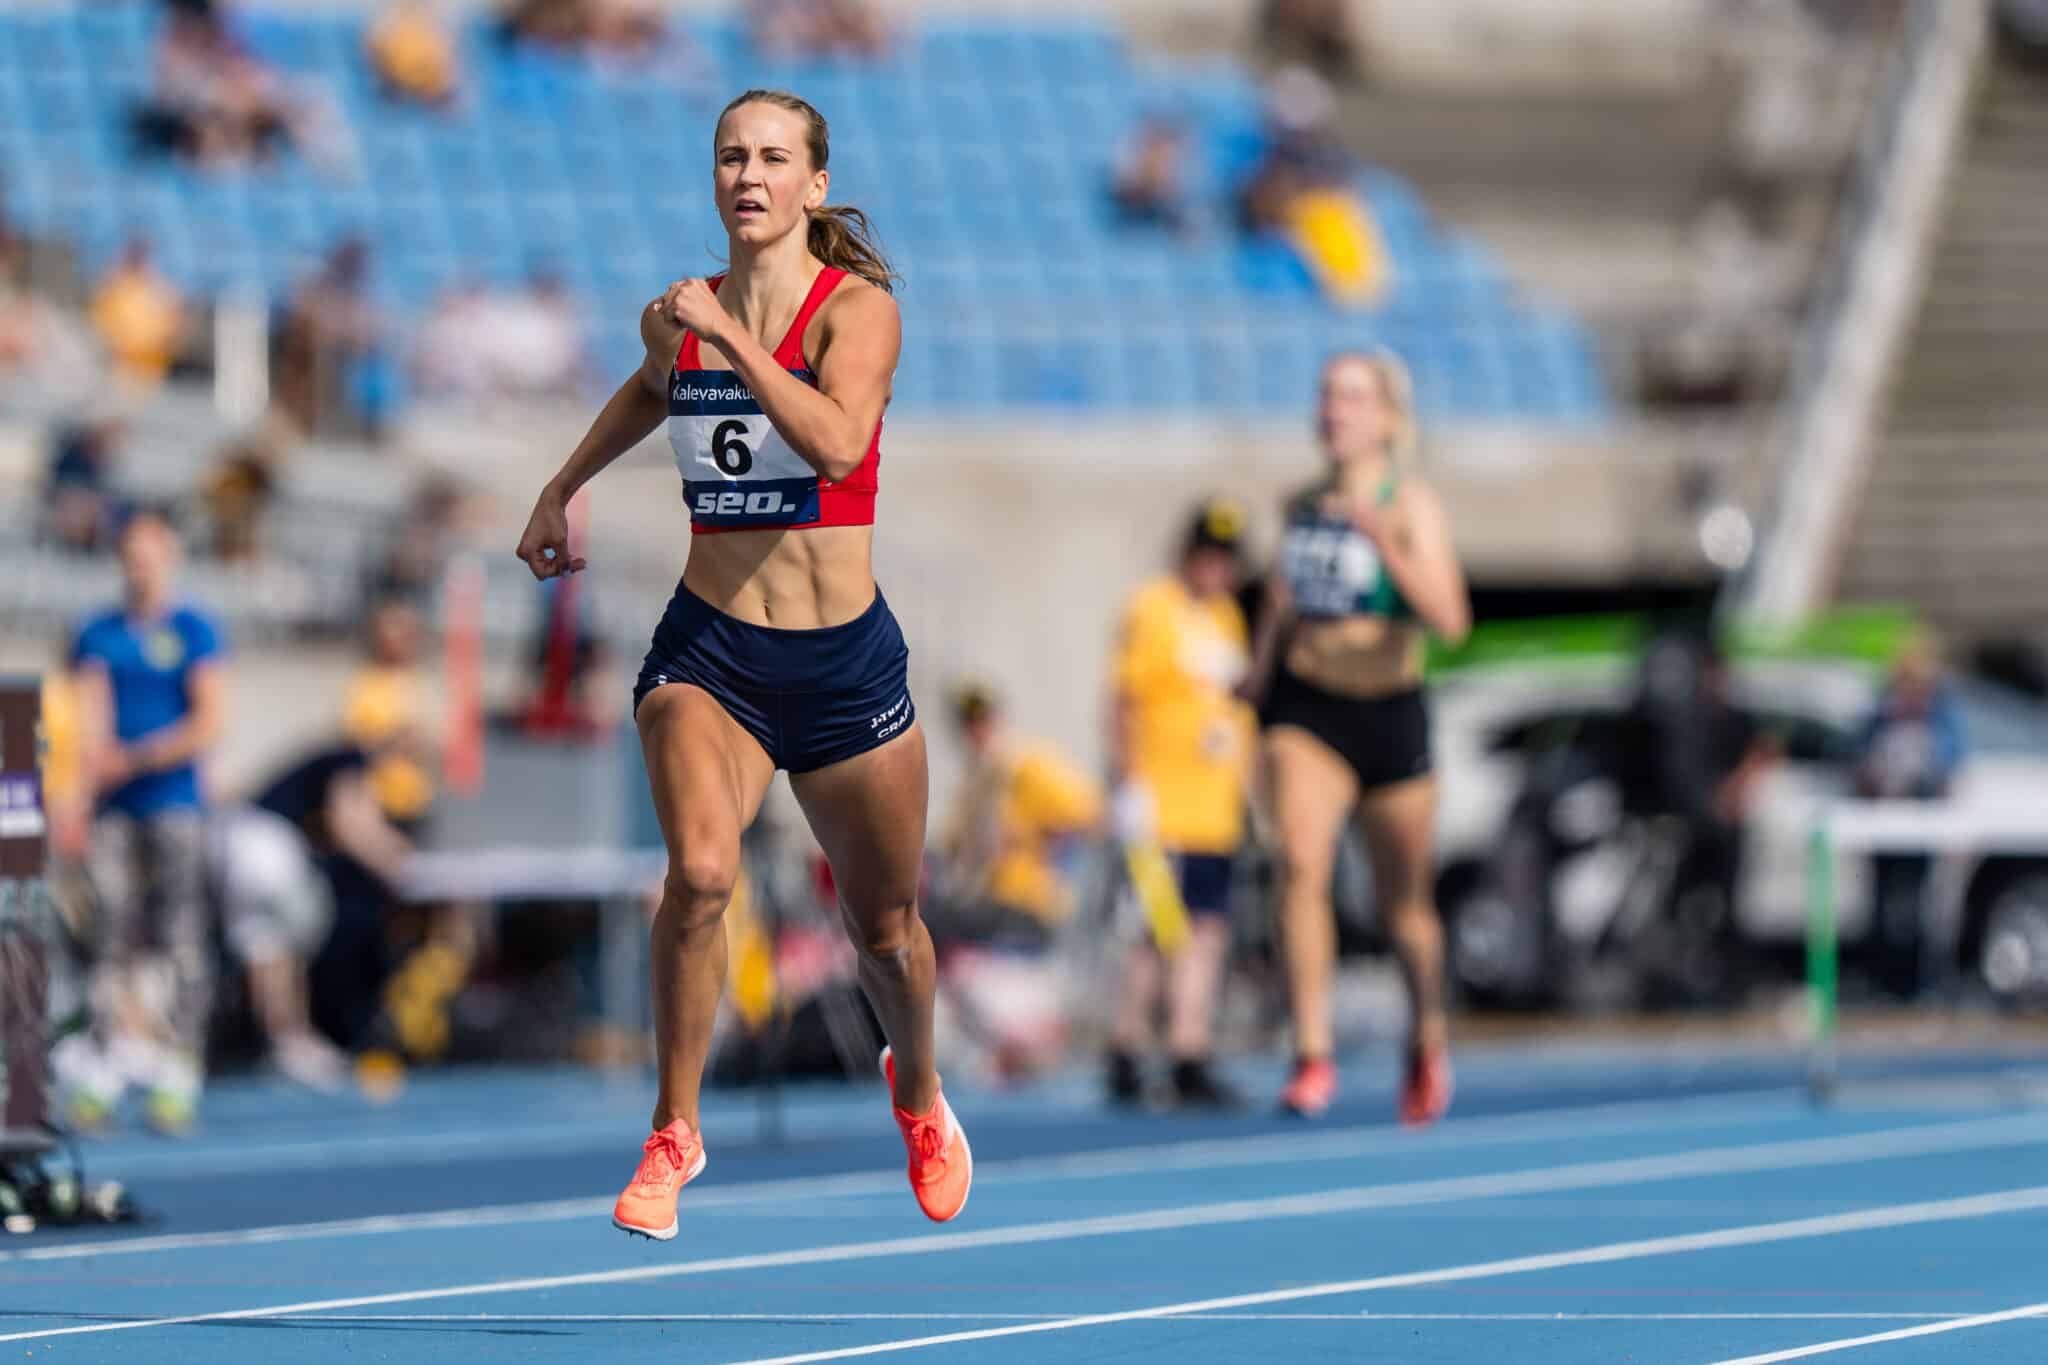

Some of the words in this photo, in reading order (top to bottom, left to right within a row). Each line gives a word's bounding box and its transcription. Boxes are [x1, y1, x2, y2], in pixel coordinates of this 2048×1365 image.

[672, 383, 755, 401] Kalevavaku
[711, 419, 753, 476] 6
[694, 491, 796, 515] seo.
